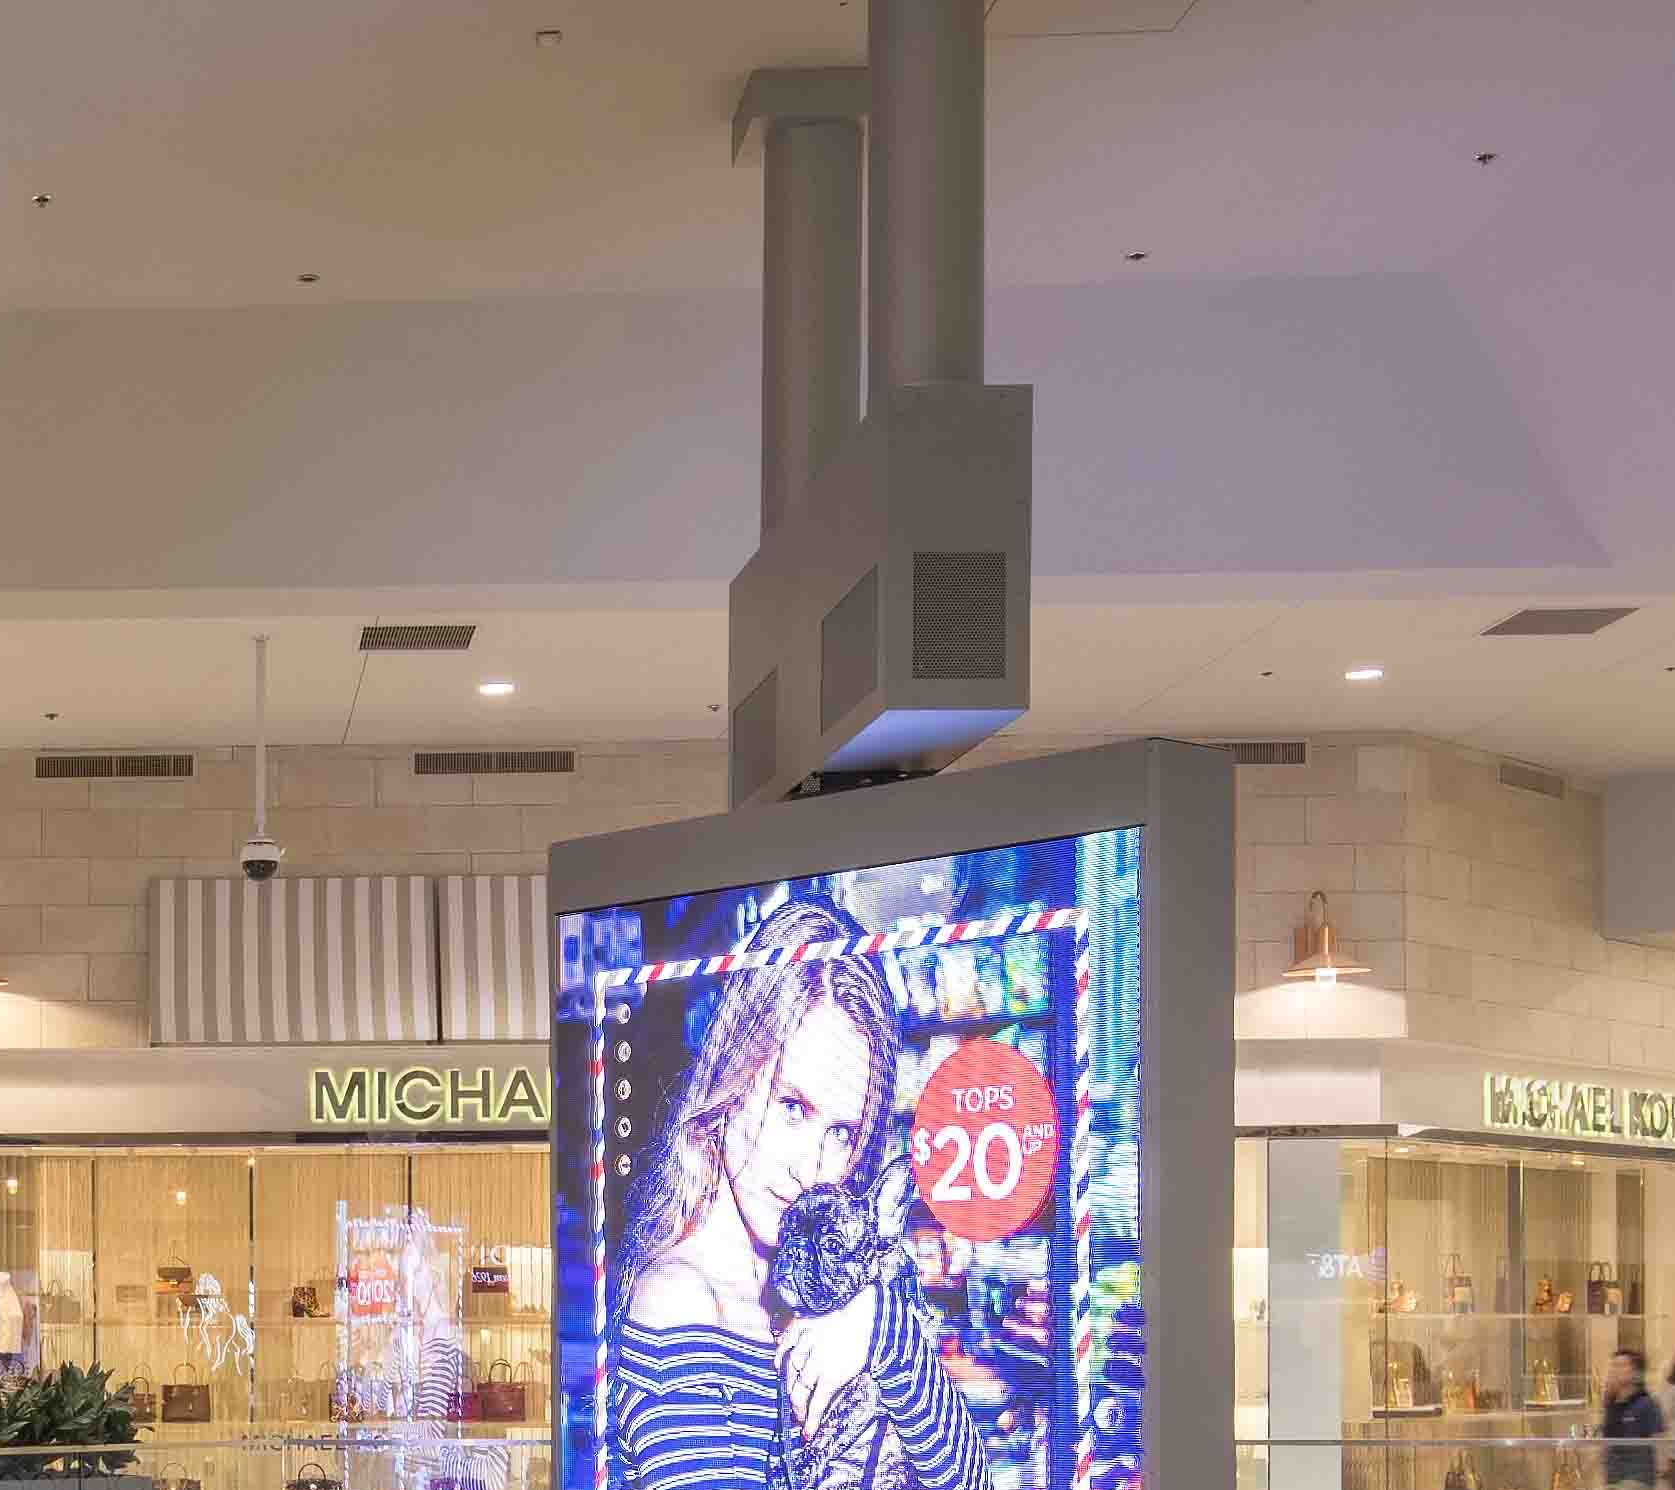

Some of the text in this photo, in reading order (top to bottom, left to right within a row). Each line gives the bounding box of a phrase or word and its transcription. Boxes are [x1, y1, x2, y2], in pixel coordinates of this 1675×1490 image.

[313, 1069, 550, 1121] MICHA
[951, 1086, 1015, 1113] TOPS
[1483, 1073, 1623, 1135] MICHAEL
[912, 1122, 1023, 1201] $20
